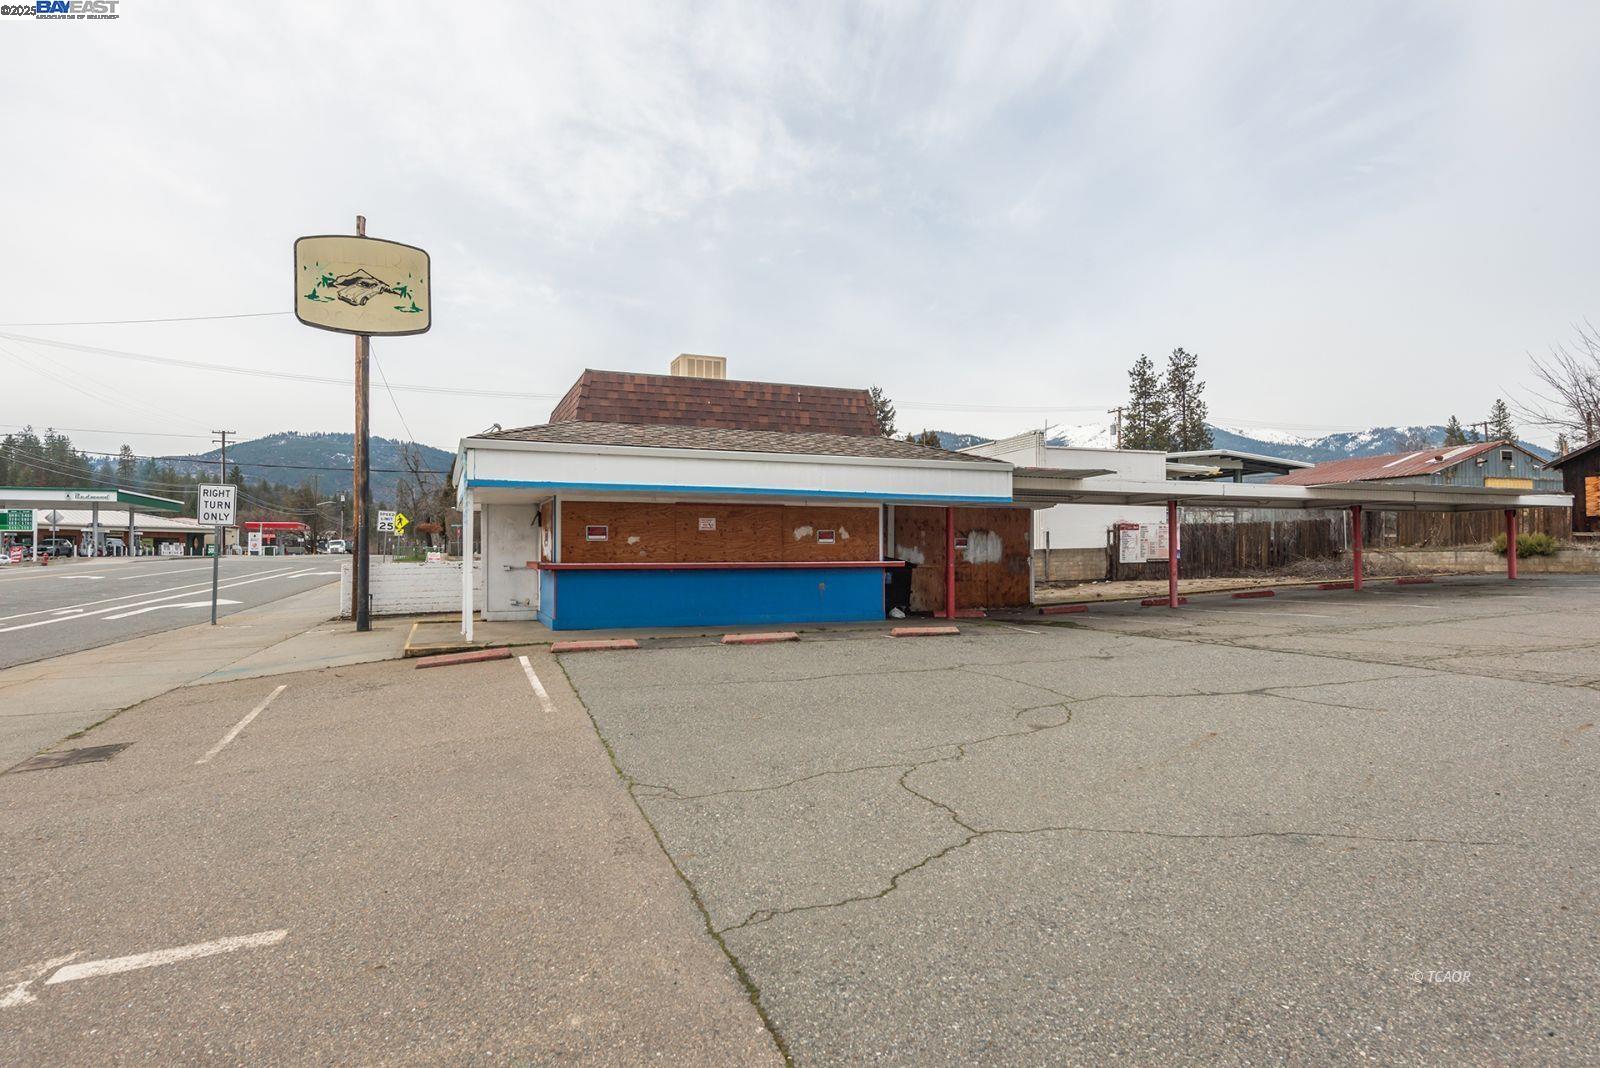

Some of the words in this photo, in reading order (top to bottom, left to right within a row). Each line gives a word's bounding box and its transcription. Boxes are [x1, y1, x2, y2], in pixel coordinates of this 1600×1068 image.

[203, 489, 230, 497] RIGHT
[204, 501, 230, 509] TURN
[379, 522, 394, 530] 25
